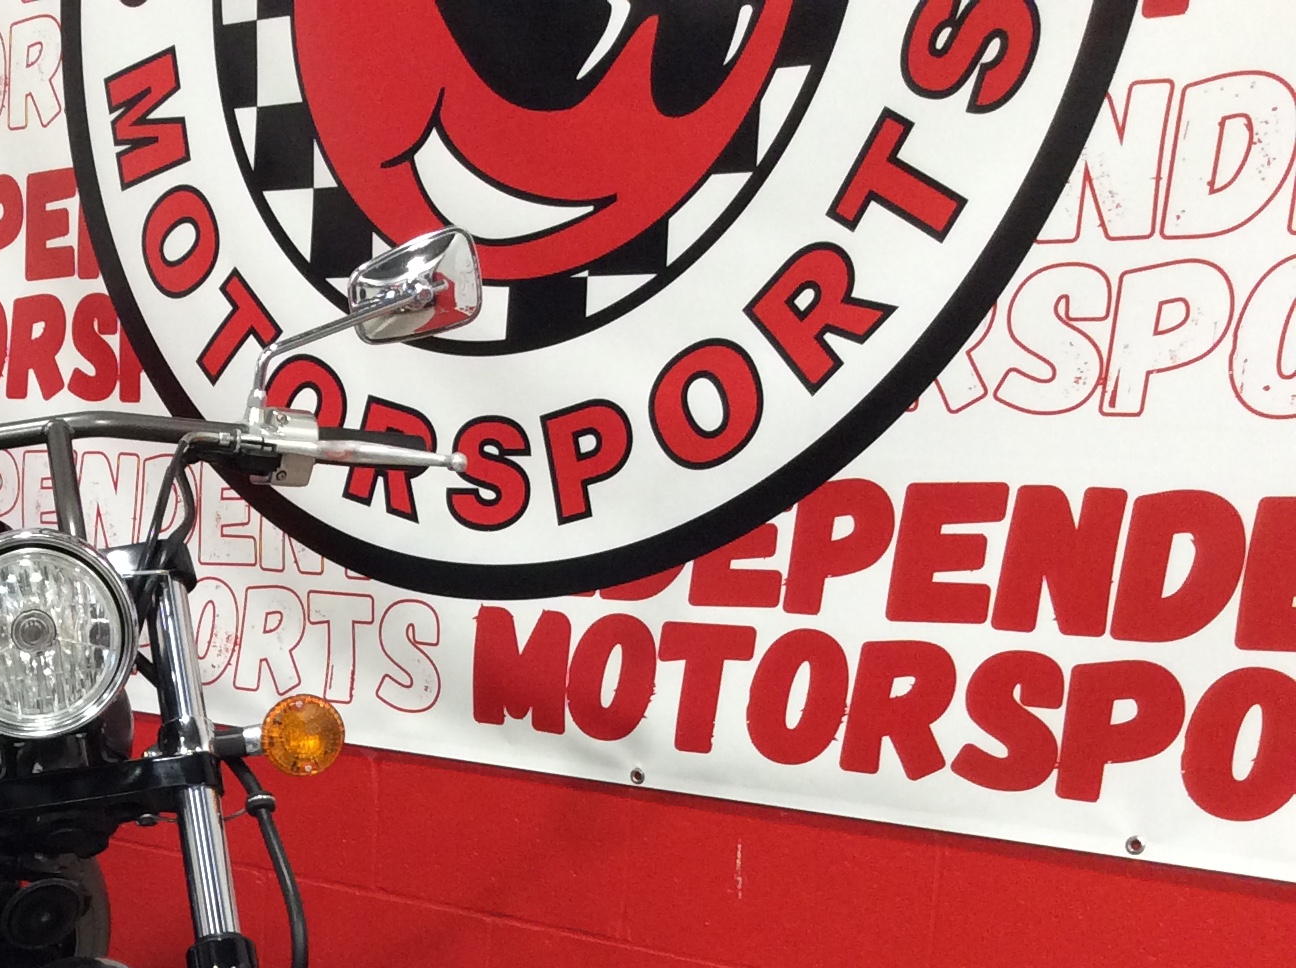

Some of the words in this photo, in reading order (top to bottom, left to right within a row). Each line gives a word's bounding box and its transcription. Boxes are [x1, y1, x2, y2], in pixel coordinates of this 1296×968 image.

[1035, 70, 1296, 243] ND
[104, 0, 1041, 532] MOTORSPORTS
[472, 604, 1296, 822] MOTORSPO
